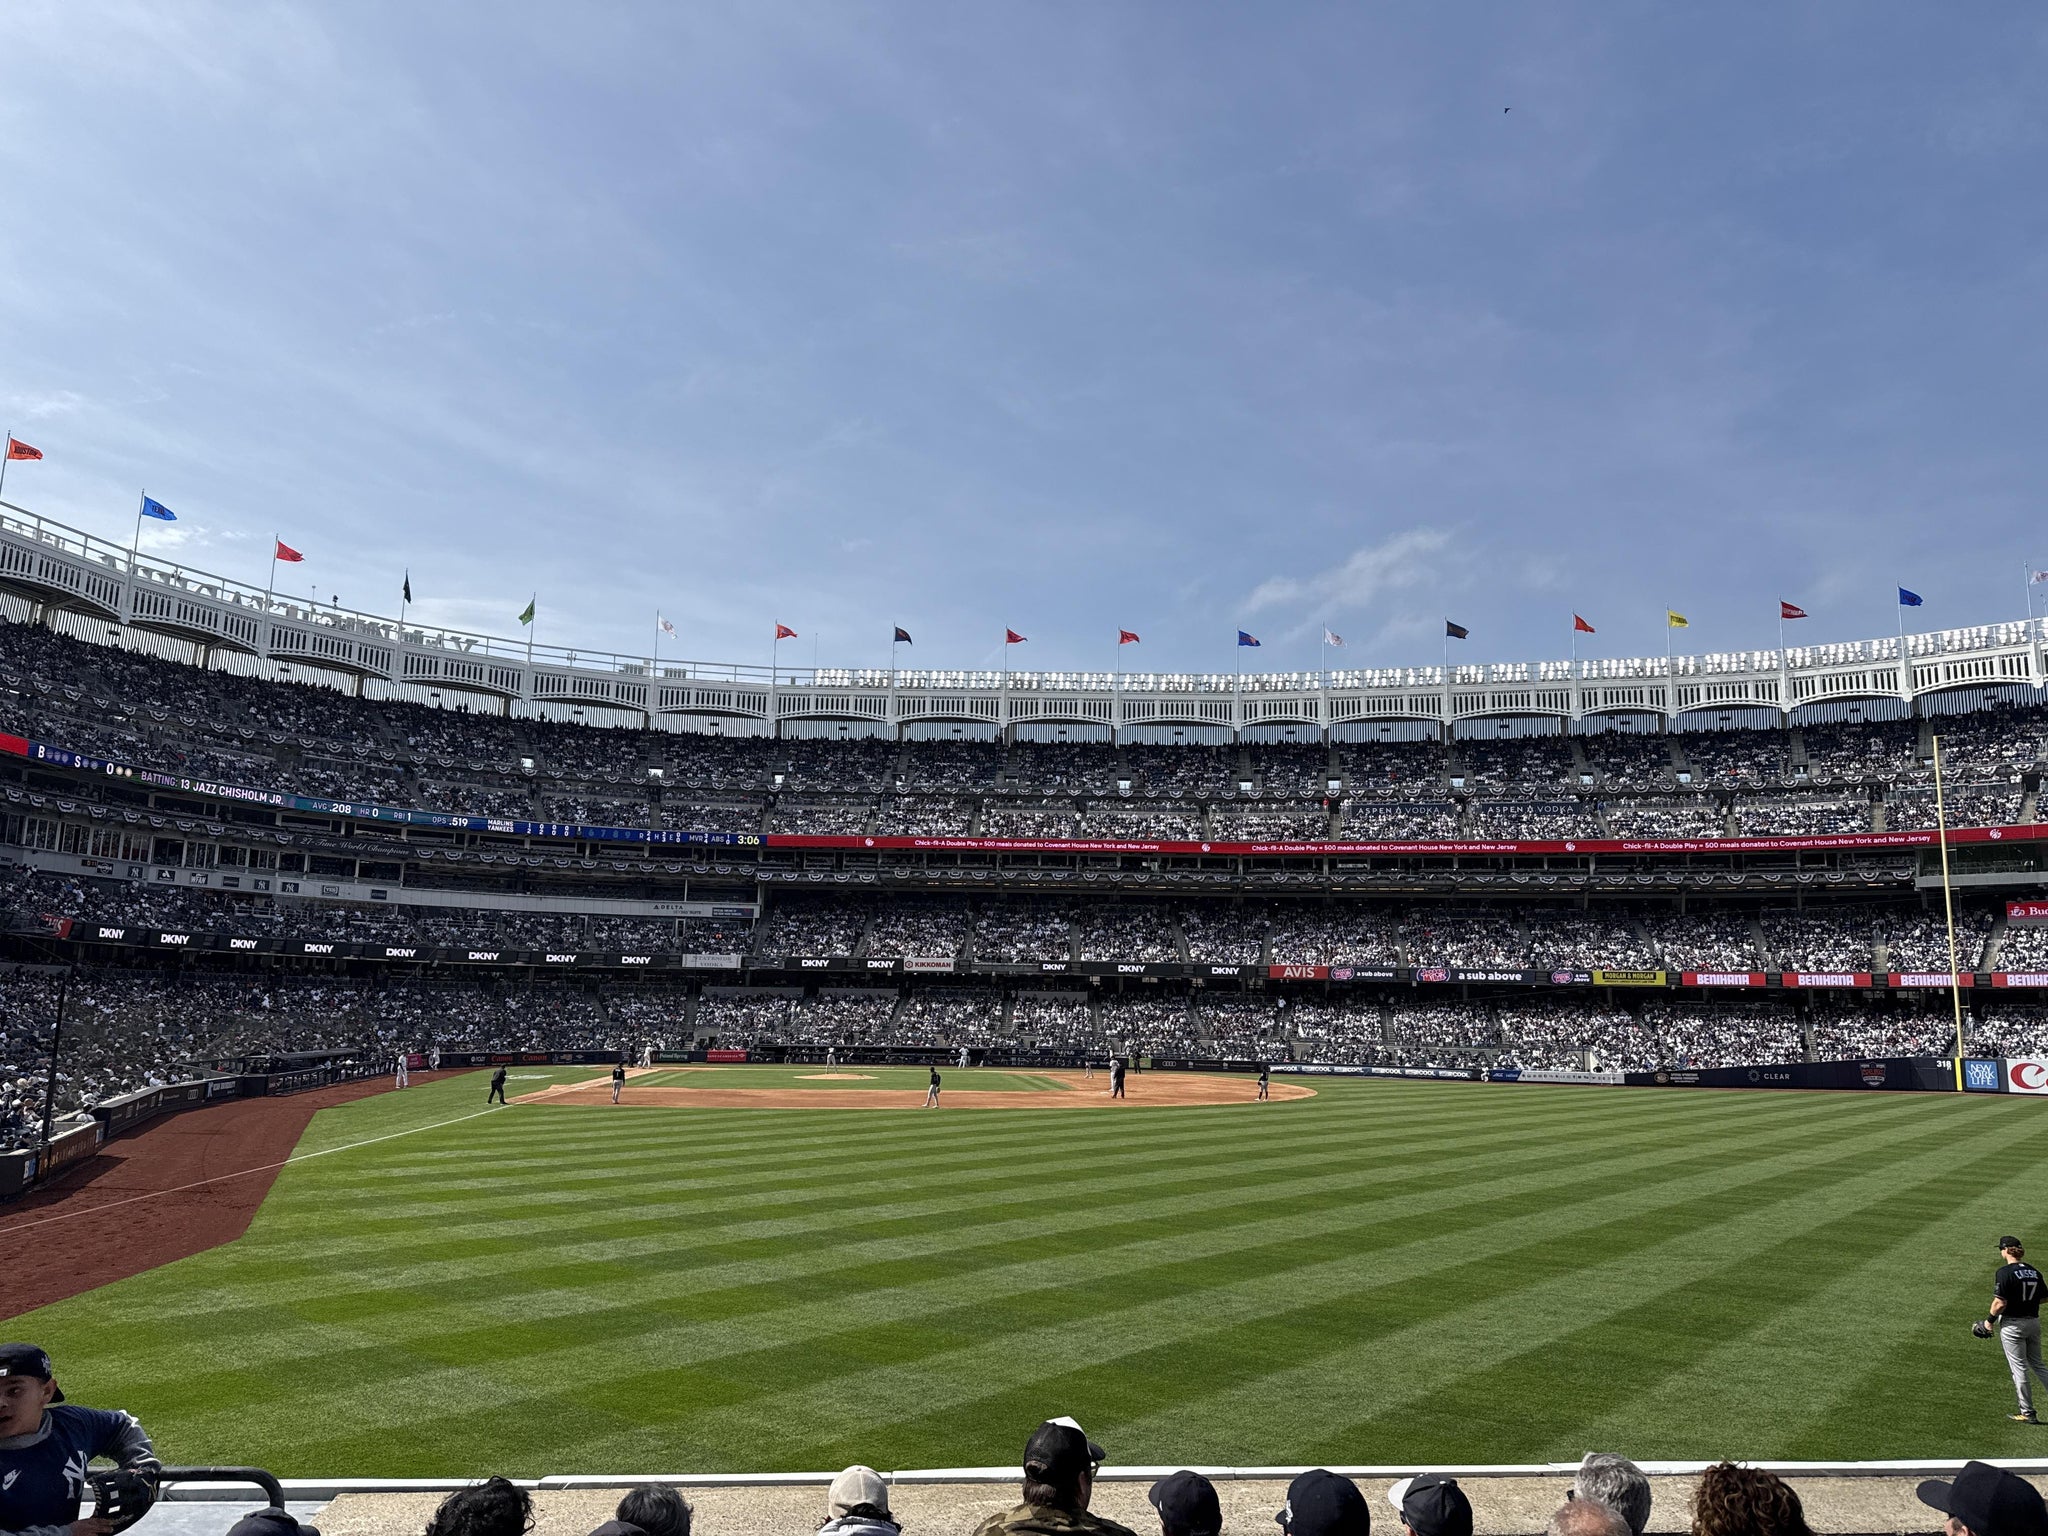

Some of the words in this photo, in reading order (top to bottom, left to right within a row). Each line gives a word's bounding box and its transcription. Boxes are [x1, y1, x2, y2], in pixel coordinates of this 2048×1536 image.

[38, 746, 44, 758] B
[75, 756, 81, 767] S
[141, 772, 178, 787] BATTING:
[181, 779, 190, 789] 13
[193, 782, 216, 794] JAZZ
[219, 786, 267, 802] CHISHOLM
[269, 795, 284, 805] JR.
[313, 802, 327, 810] AVG
[329, 803, 351, 813] .208
[449, 818, 468, 826] .519
[738, 836, 760, 845] 3:06
[340, 842, 366, 852] World
[368, 844, 409, 856] Champions
[99, 928, 124, 940] DKNY
[160, 934, 190, 946] DKNY
[230, 939, 257, 950] DKNY
[304, 944, 334, 954] DKNY
[386, 948, 416, 957] DKNY
[469, 952, 500, 960] DKNY
[546, 955, 576, 963] DKNY
[1212, 967, 1240, 975] DKNY
[1284, 967, 1315, 978] AVIS
[1467, 971, 1485, 980] sub
[1487, 971, 1522, 980] above
[1697, 974, 1749, 985] BENIHANA
[1798, 975, 1854, 986] BENIHANA
[1968, 1070, 1995, 1079] YORK
[1972, 1077, 1993, 1086] LIFE
[2022, 1281, 2038, 1301] 17
